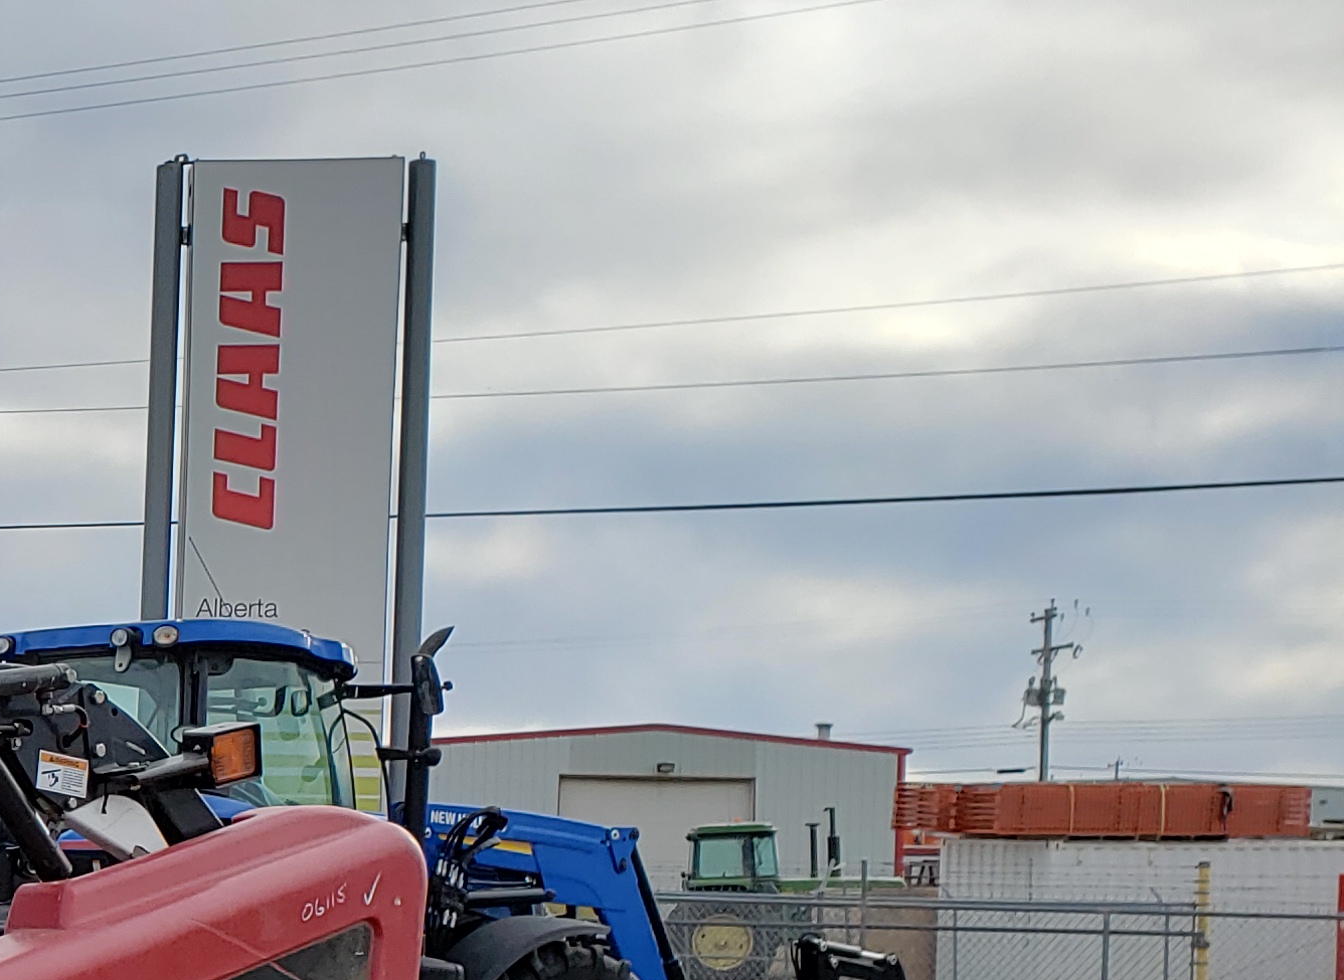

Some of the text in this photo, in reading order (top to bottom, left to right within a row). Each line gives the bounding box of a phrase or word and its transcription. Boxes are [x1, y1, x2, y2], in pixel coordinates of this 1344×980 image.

[212, 187, 286, 531] CLAAS
[195, 597, 279, 619] Alberta
[430, 809, 457, 825] NEW
